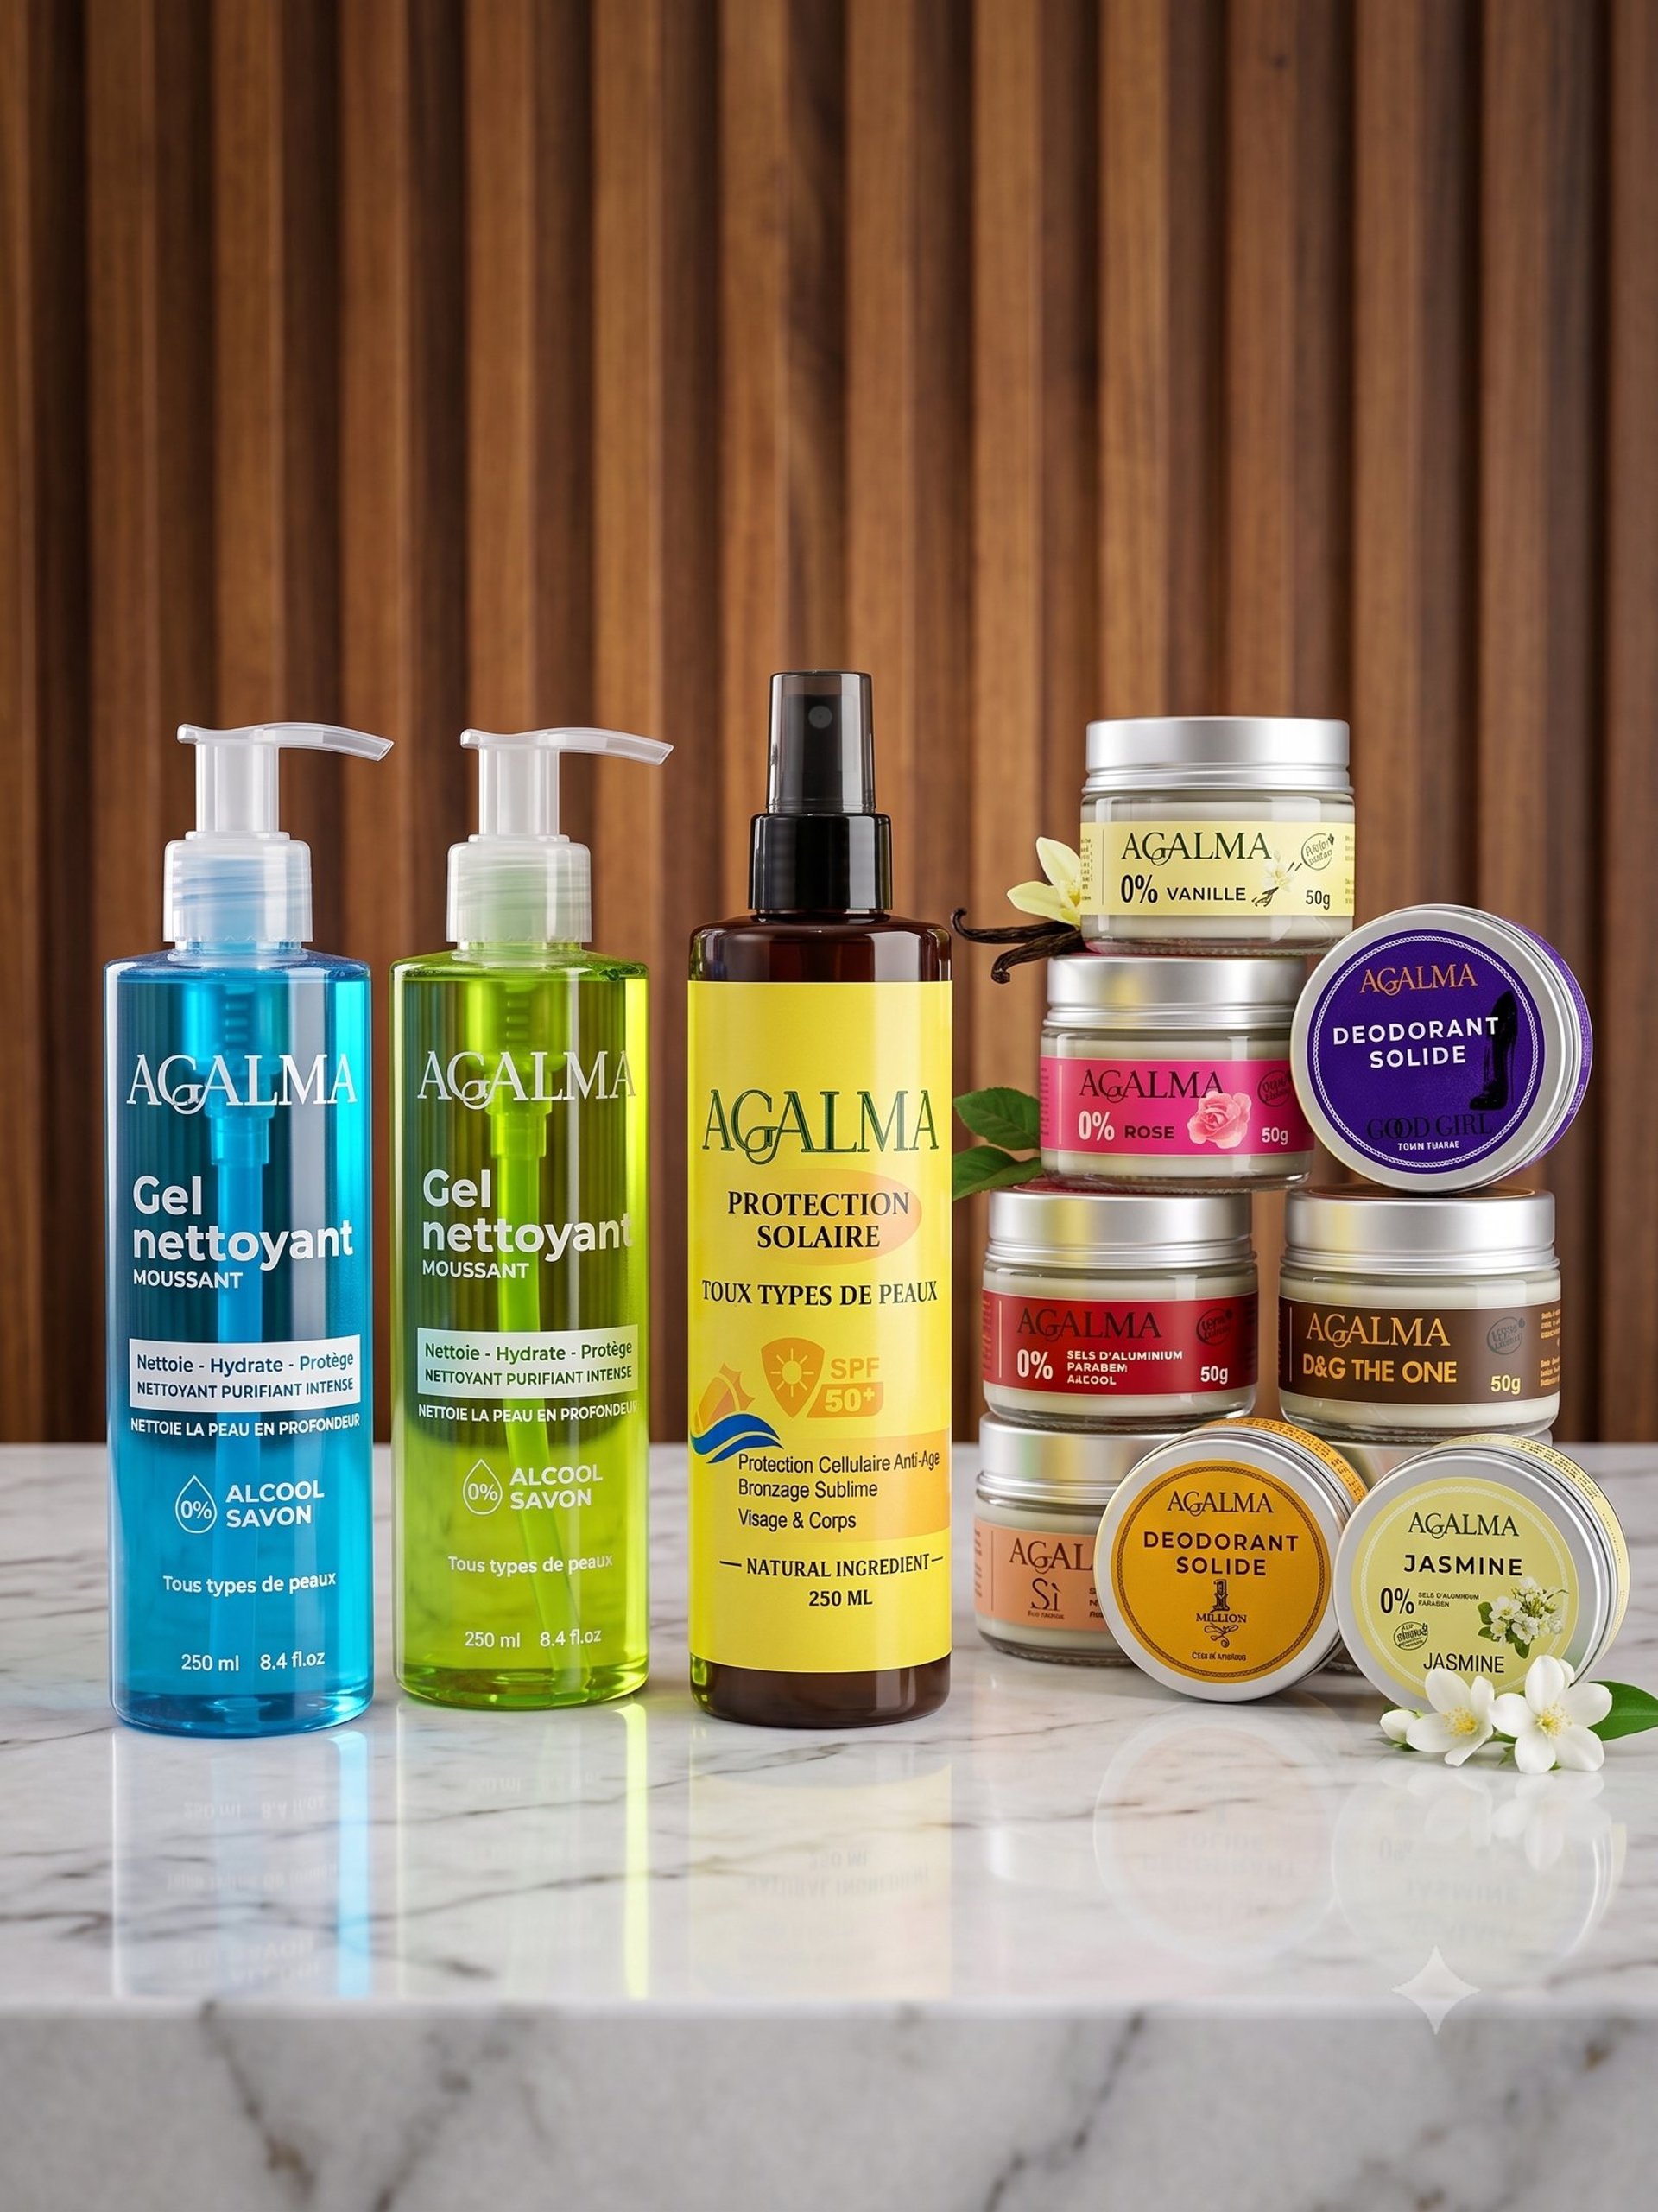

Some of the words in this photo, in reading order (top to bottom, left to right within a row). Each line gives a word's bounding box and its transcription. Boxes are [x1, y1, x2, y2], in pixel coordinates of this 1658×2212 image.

[1121, 833, 1272, 865] AGALMA
[1121, 874, 1158, 903] 0%
[1166, 887, 1246, 900] VANILLE
[1306, 890, 1330, 910] 50g
[1360, 963, 1478, 996] AGALMA
[1332, 1017, 1498, 1045] DEODORANT
[1370, 1045, 1466, 1068] SOLIDE
[126, 1054, 358, 1115] AGALMA
[418, 1050, 636, 1110] AGALMA
[1079, 1069, 1224, 1103] AGALMA
[702, 1089, 939, 1165] AGALMA
[1079, 1111, 1115, 1141] 0%
[1124, 1126, 1174, 1139] ROSE
[1262, 1127, 1288, 1145] 50g
[1367, 1117, 1430, 1140] GOOD
[1436, 1113, 1492, 1137] GIRL
[133, 1176, 201, 1215] Gel
[423, 1169, 490, 1208] Gel
[728, 1191, 909, 1216] PROTECTION
[133, 1220, 353, 1271] nettoyant
[423, 1213, 633, 1262] nettoyant
[757, 1226, 880, 1248] SOLAIRE
[133, 1269, 243, 1288] MOUSSANT
[422, 1259, 528, 1279] MOUSSANT
[702, 1279, 751, 1302] TOUX
[757, 1285, 832, 1306] TYPES
[840, 1285, 871, 1304] DE
[879, 1281, 937, 1304] PEAUX
[1017, 1308, 1161, 1341] AGALMA
[1306, 1313, 1451, 1348] AGALMA
[425, 1343, 479, 1360] Nettoie
[497, 1347, 565, 1367] Hydrate
[581, 1341, 631, 1361] Protège
[1017, 1349, 1054, 1380] 0%
[1067, 1351, 1096, 1360] SELS
[1099, 1351, 1183, 1360] D'ALUMINIUM
[137, 1354, 193, 1372] Nettoie
[211, 1357, 282, 1379] Hydrate
[301, 1353, 353, 1373] Protège
[425, 1369, 502, 1385] NETTOYANT
[507, 1371, 583, 1385] PURIFIANT
[586, 1366, 631, 1382] INTENSE
[830, 1357, 880, 1379] SPF
[1200, 1366, 1228, 1384] 50g
[1303, 1353, 1345, 1379] D&G
[1351, 1359, 1395, 1382] THE
[1402, 1361, 1457, 1383] ONE
[137, 1382, 217, 1398] NETTOYANT
[222, 1383, 301, 1398] PURIFIANT
[307, 1378, 353, 1394] INTENSE
[1490, 1375, 1521, 1395] 50g
[825, 1387, 875, 1412] 50+
[419, 1404, 467, 1421] NETTOIE
[471, 1409, 489, 1422] LA
[493, 1409, 533, 1423] PEAU
[538, 1409, 556, 1422] EN
[561, 1400, 638, 1421] PROFONDEUR
[130, 1418, 182, 1435] NETTOIE
[186, 1423, 204, 1436] LA
[209, 1423, 250, 1436] PEAU
[255, 1423, 273, 1436] EN
[279, 1415, 359, 1434] PROFONDEUR
[738, 1454, 813, 1473] Protection
[819, 1455, 890, 1474] Cellulaire
[894, 1450, 940, 1471] Anti-Age
[510, 1465, 602, 1486] ALCOOL
[225, 1480, 324, 1503] ALCOOL
[467, 1483, 498, 1501] 0%
[510, 1489, 592, 1510] SAVON
[739, 1479, 809, 1502] Bronzage
[815, 1480, 878, 1498] Sublime
[180, 1500, 212, 1519] 0%
[1167, 1491, 1274, 1517] AGALMA
[226, 1505, 311, 1528] SAVON
[738, 1508, 788, 1532] Visage
[793, 1512, 803, 1529] &
[809, 1512, 856, 1532] Corps
[1408, 1512, 1519, 1538] AGALMA
[1143, 1531, 1299, 1551] DEODORANT
[448, 1556, 484, 1573] Tous
[490, 1558, 537, 1577] types
[543, 1557, 564, 1572] de
[568, 1555, 612, 1575] peaux
[747, 1558, 831, 1577] NATURAL
[836, 1554, 930, 1577] INGREDIENT
[1009, 1537, 1093, 1574] AGAL
[1176, 1556, 1266, 1575] SOLIDE
[1403, 1555, 1522, 1576] JASMINE
[163, 1575, 201, 1593] Tous
[206, 1577, 256, 1597] types
[262, 1575, 283, 1592] de
[289, 1573, 336, 1594] peaux
[809, 1591, 841, 1606] 250
[847, 1589, 872, 1605] ML
[1381, 1588, 1414, 1614] 0%
[1196, 1613, 1246, 1623] MILLION
[465, 1632, 494, 1647] 250
[501, 1632, 520, 1648] ml
[540, 1632, 565, 1647] 8.4
[569, 1630, 601, 1645] fl.oz
[181, 1654, 213, 1670] 250
[218, 1655, 239, 1671] ml
[261, 1652, 287, 1670] 8.4
[292, 1651, 325, 1667] fl.oz
[1424, 1653, 1504, 1673] JASMINE
